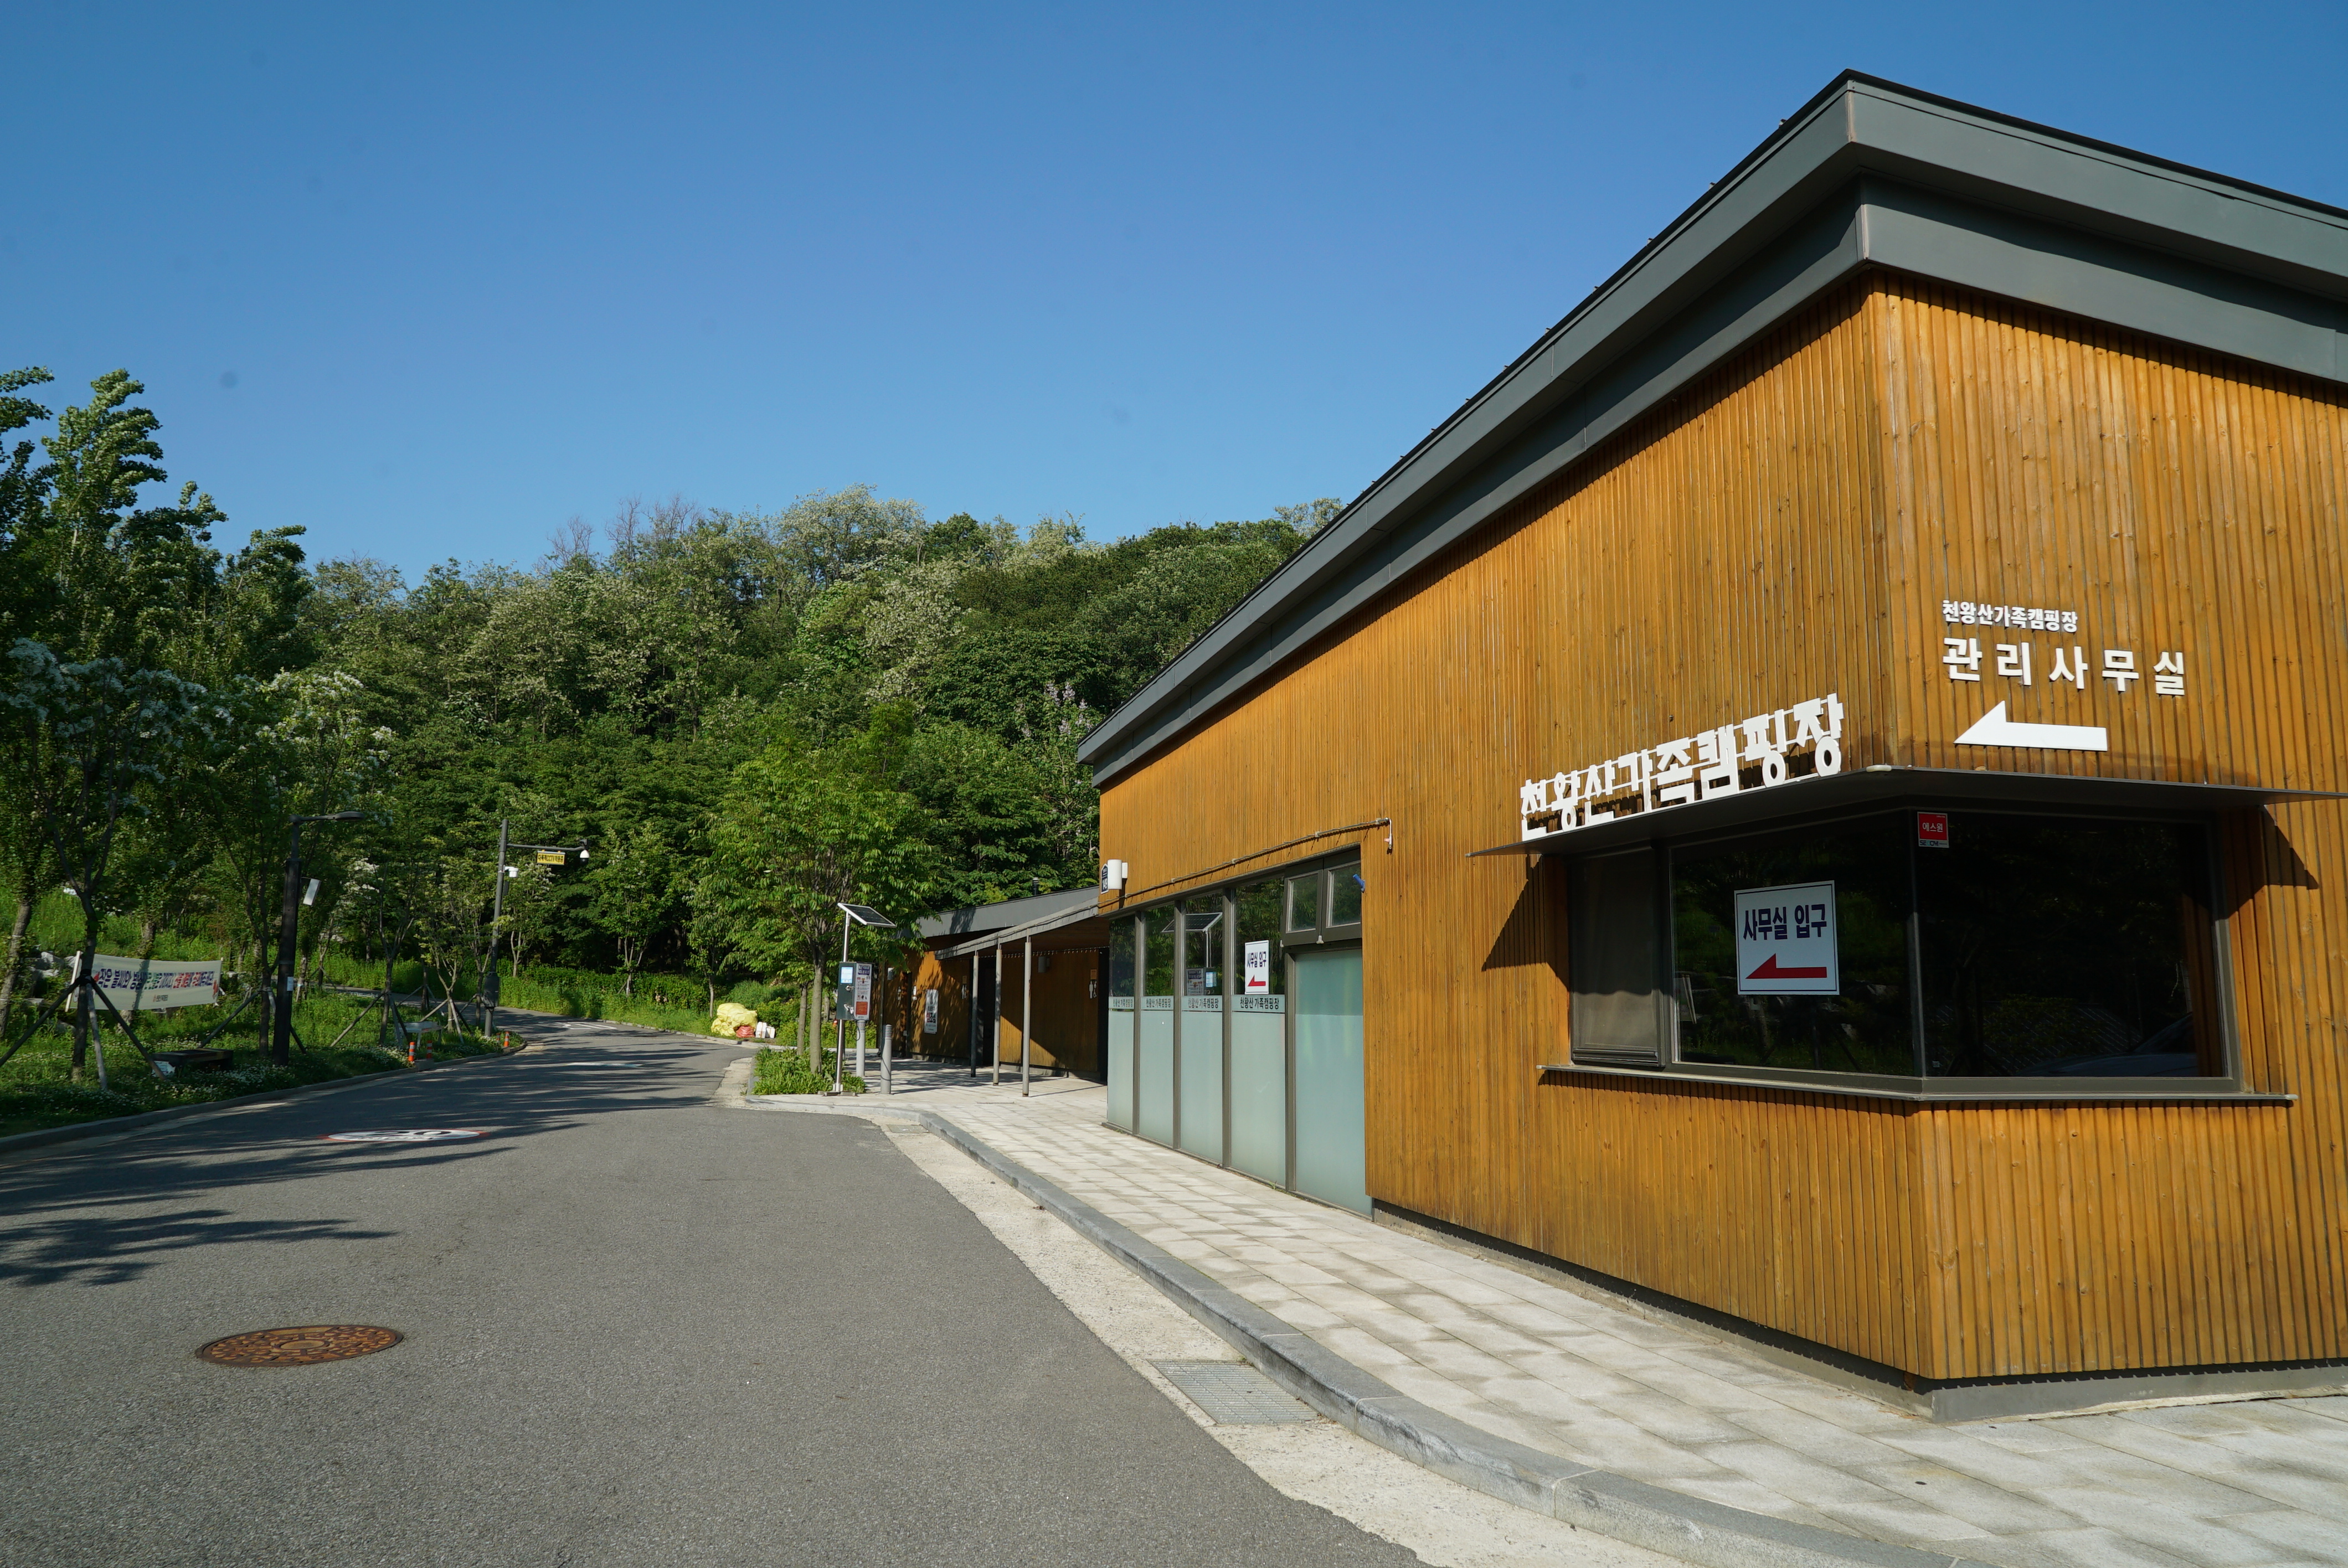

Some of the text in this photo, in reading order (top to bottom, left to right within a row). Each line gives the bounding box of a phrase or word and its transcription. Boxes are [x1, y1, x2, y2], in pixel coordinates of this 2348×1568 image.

[1942, 599, 2077, 633] 천왕산가족캠핑장
[1942, 637, 2185, 696] 관리사무실
[1520, 693, 1845, 842] 천왕산가족캠핑장
[1922, 822, 1943, 832] 에스원
[1743, 904, 1827, 941] 사무실 입구
[1247, 951, 1266, 968] 사무실 입구
